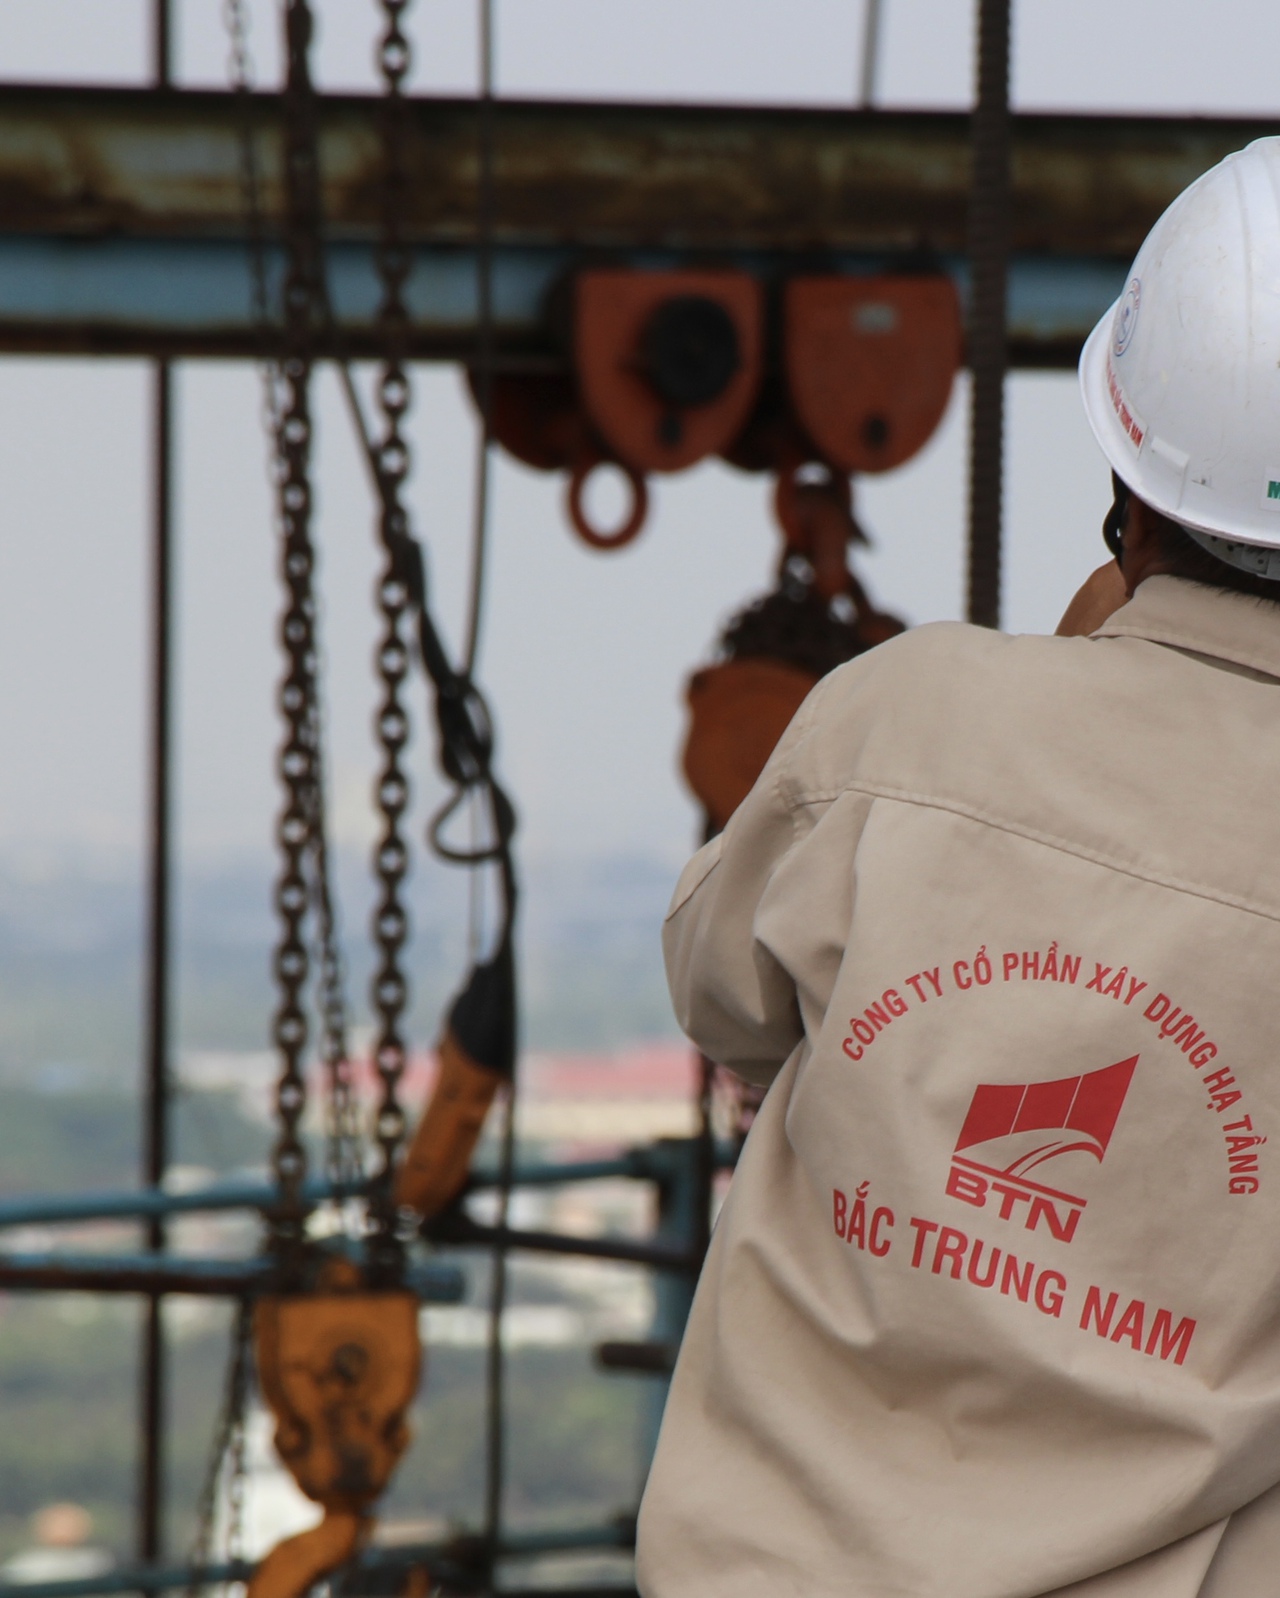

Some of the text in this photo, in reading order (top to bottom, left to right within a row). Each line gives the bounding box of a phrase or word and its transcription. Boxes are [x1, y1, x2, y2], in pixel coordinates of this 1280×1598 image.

[842, 941, 1267, 1194] CÔNG TY CỔ PHẦN XÂY DỰNG HẠ TẦNG
[833, 1180, 1198, 1366] BẮC TRUNG NAM
[945, 1166, 1082, 1243] BTN
